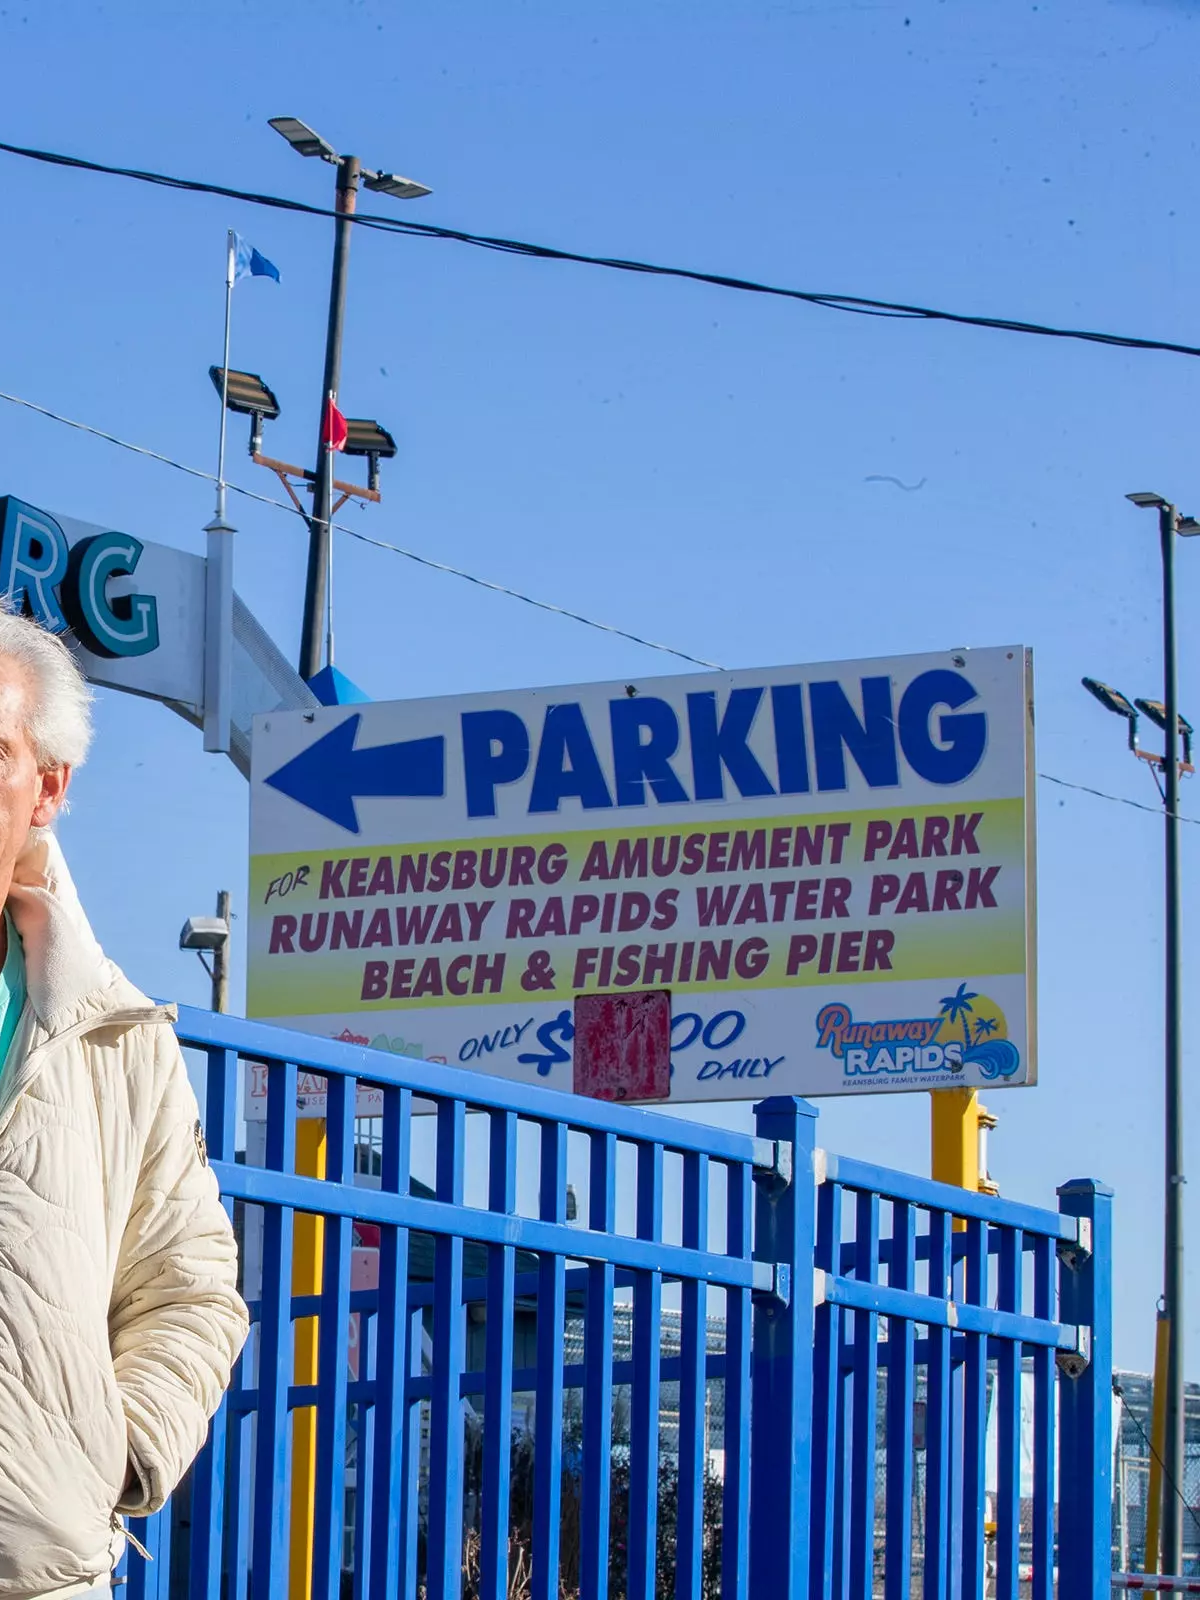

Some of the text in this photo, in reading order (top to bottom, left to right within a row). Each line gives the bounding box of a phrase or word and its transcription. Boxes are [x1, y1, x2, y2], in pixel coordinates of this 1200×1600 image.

[461, 669, 987, 818] PARKING
[265, 812, 984, 904] FOR KEANSBURG AMUSEMENT PARK
[268, 866, 1001, 954] RUNAWAY RAPIDS WATER PARK
[360, 929, 895, 1000] BEACH & FISHING PIER
[458, 1017, 534, 1062] ONLY
[817, 1003, 943, 1056] Runaway
[696, 1056, 785, 1081] DAILY
[842, 1074, 966, 1087] KEANSBURG FAMILY WATERPARK
[846, 1043, 962, 1073] RAPIDS
